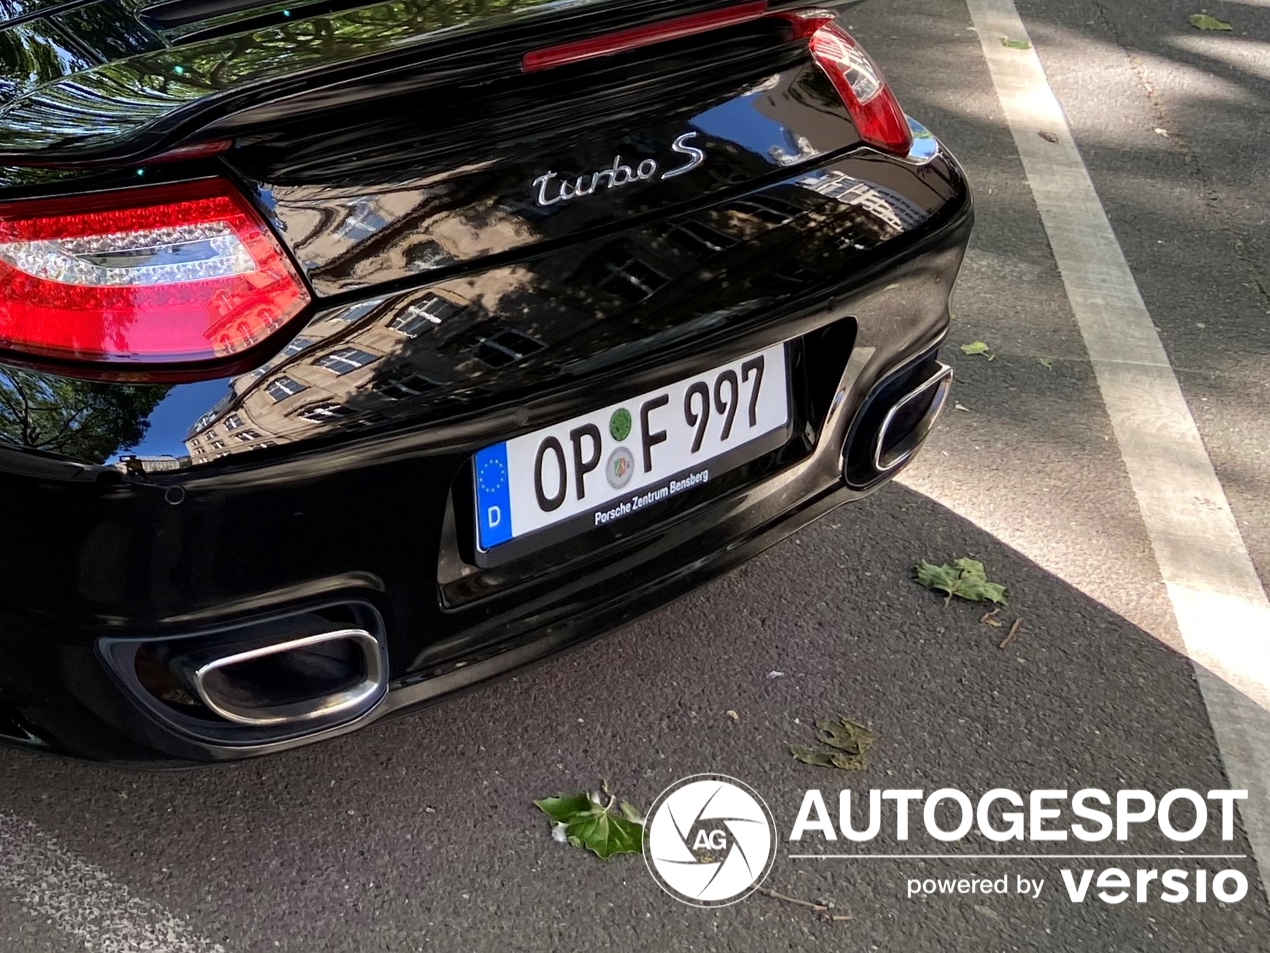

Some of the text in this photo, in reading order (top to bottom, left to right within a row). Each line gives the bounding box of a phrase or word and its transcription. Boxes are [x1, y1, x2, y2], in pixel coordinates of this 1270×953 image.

[532, 131, 706, 207] turbo S
[534, 355, 766, 512] OP F 997
[487, 504, 501, 528] D
[594, 470, 709, 526] Porsche Zentrum Bensberg
